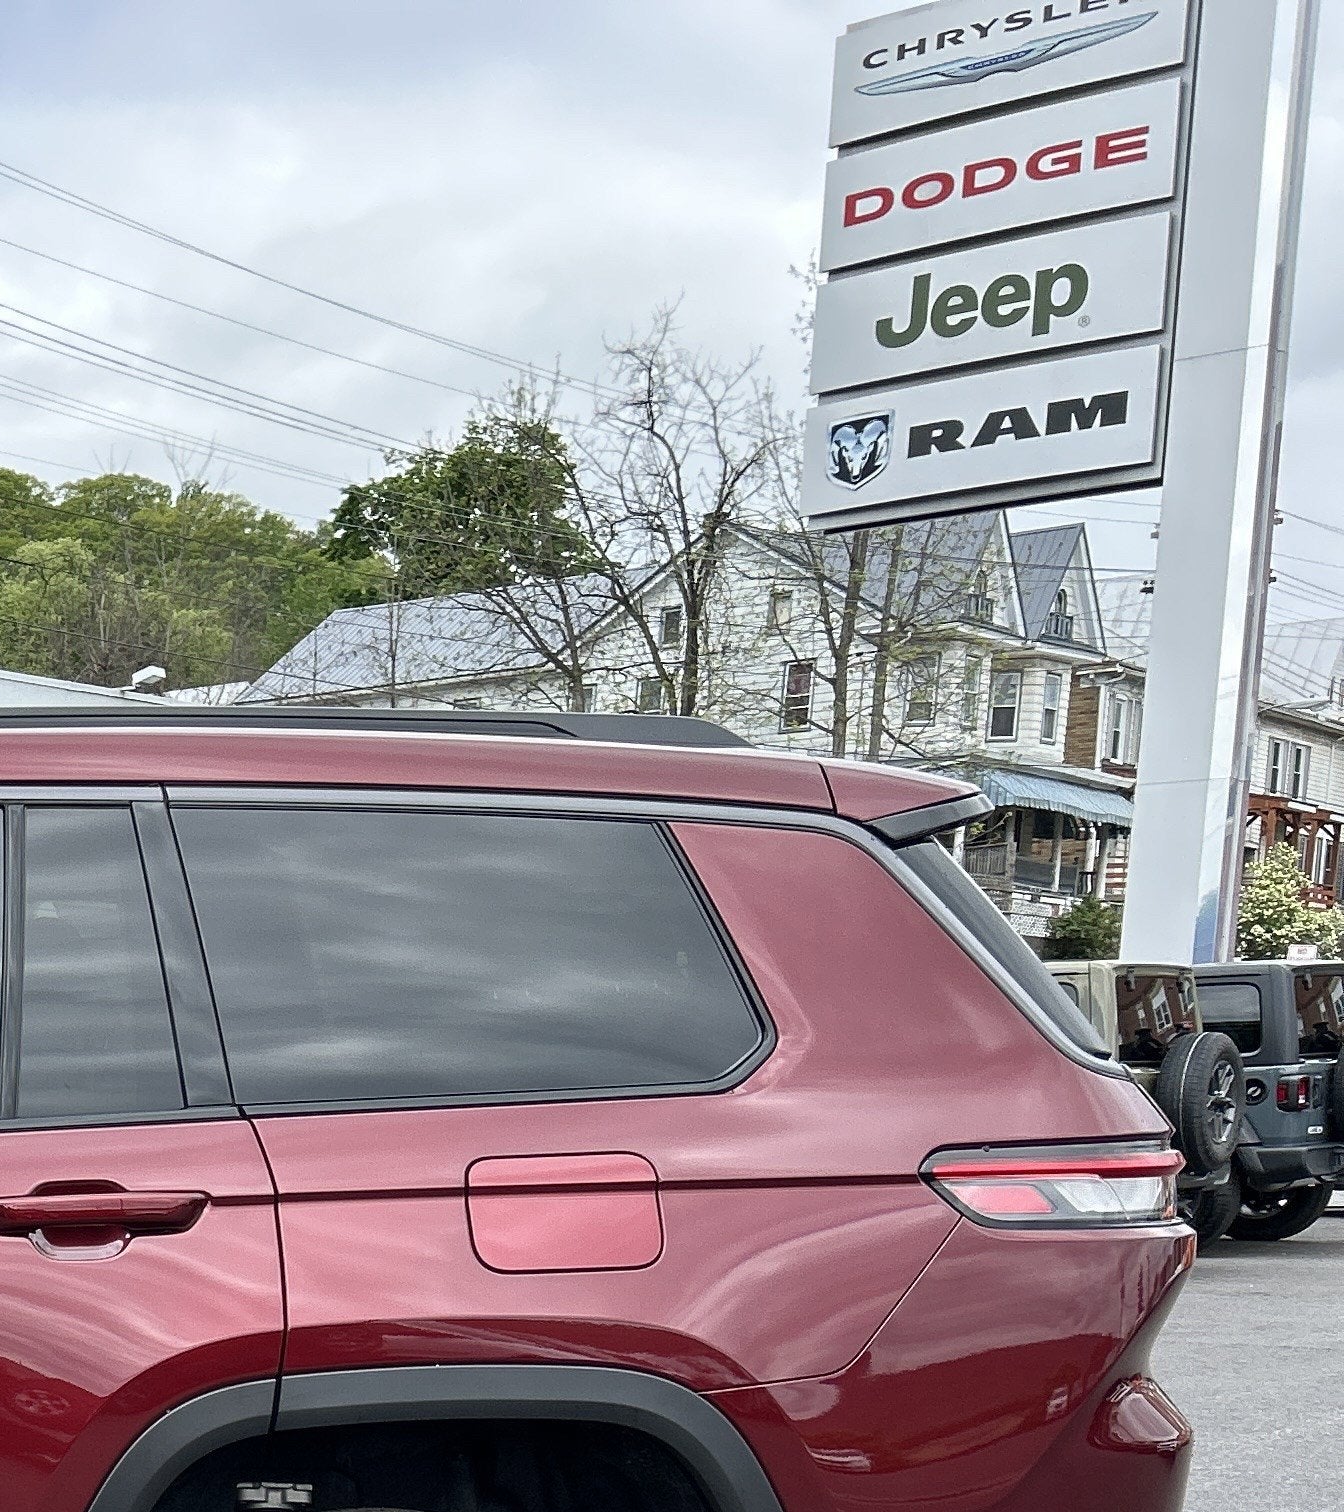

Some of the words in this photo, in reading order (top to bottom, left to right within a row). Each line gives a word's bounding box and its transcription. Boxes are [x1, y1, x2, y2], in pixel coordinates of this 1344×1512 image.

[862, 0, 1129, 69] CHRYSLE
[843, 125, 1150, 228] DODGE
[875, 262, 1089, 349] Jeep
[907, 390, 1129, 459] RAM
